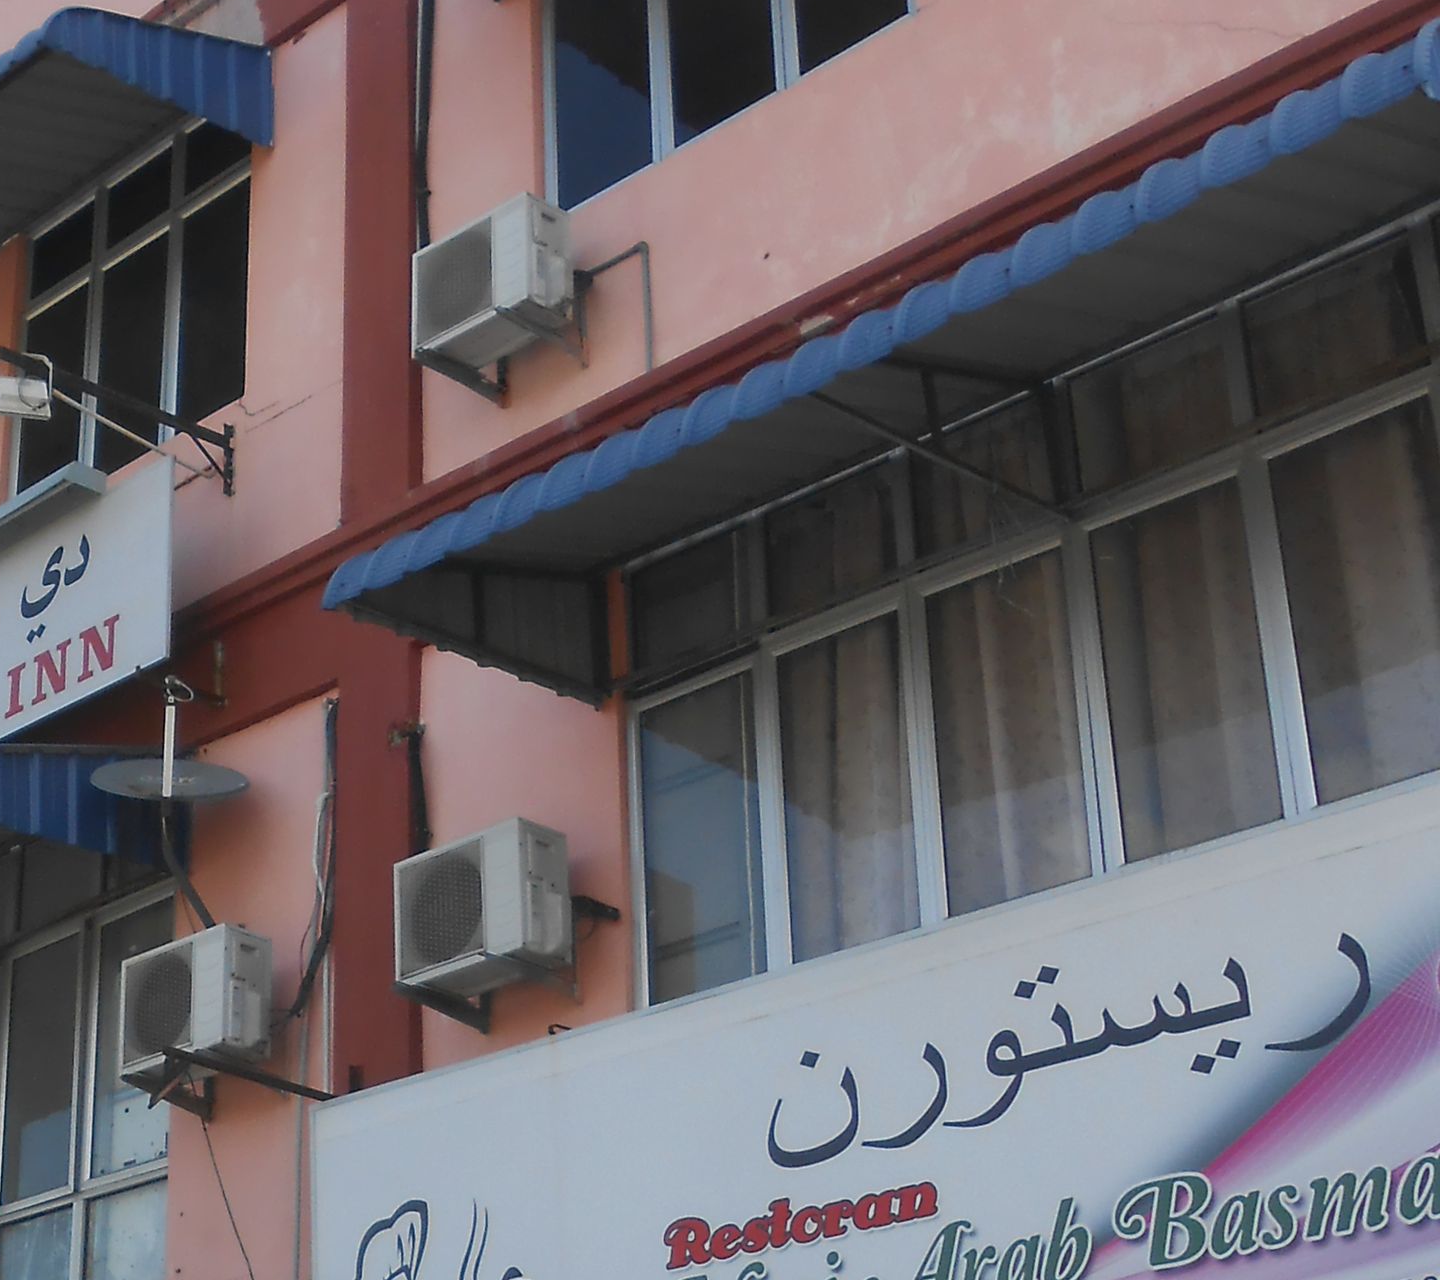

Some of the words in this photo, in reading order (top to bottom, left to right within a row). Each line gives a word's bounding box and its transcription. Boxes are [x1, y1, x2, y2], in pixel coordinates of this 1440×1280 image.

[21, 534, 90, 643] دي
[4, 614, 120, 719] INN
[767, 932, 1371, 1167] ريستورن
[664, 1181, 939, 1270] Restoran
